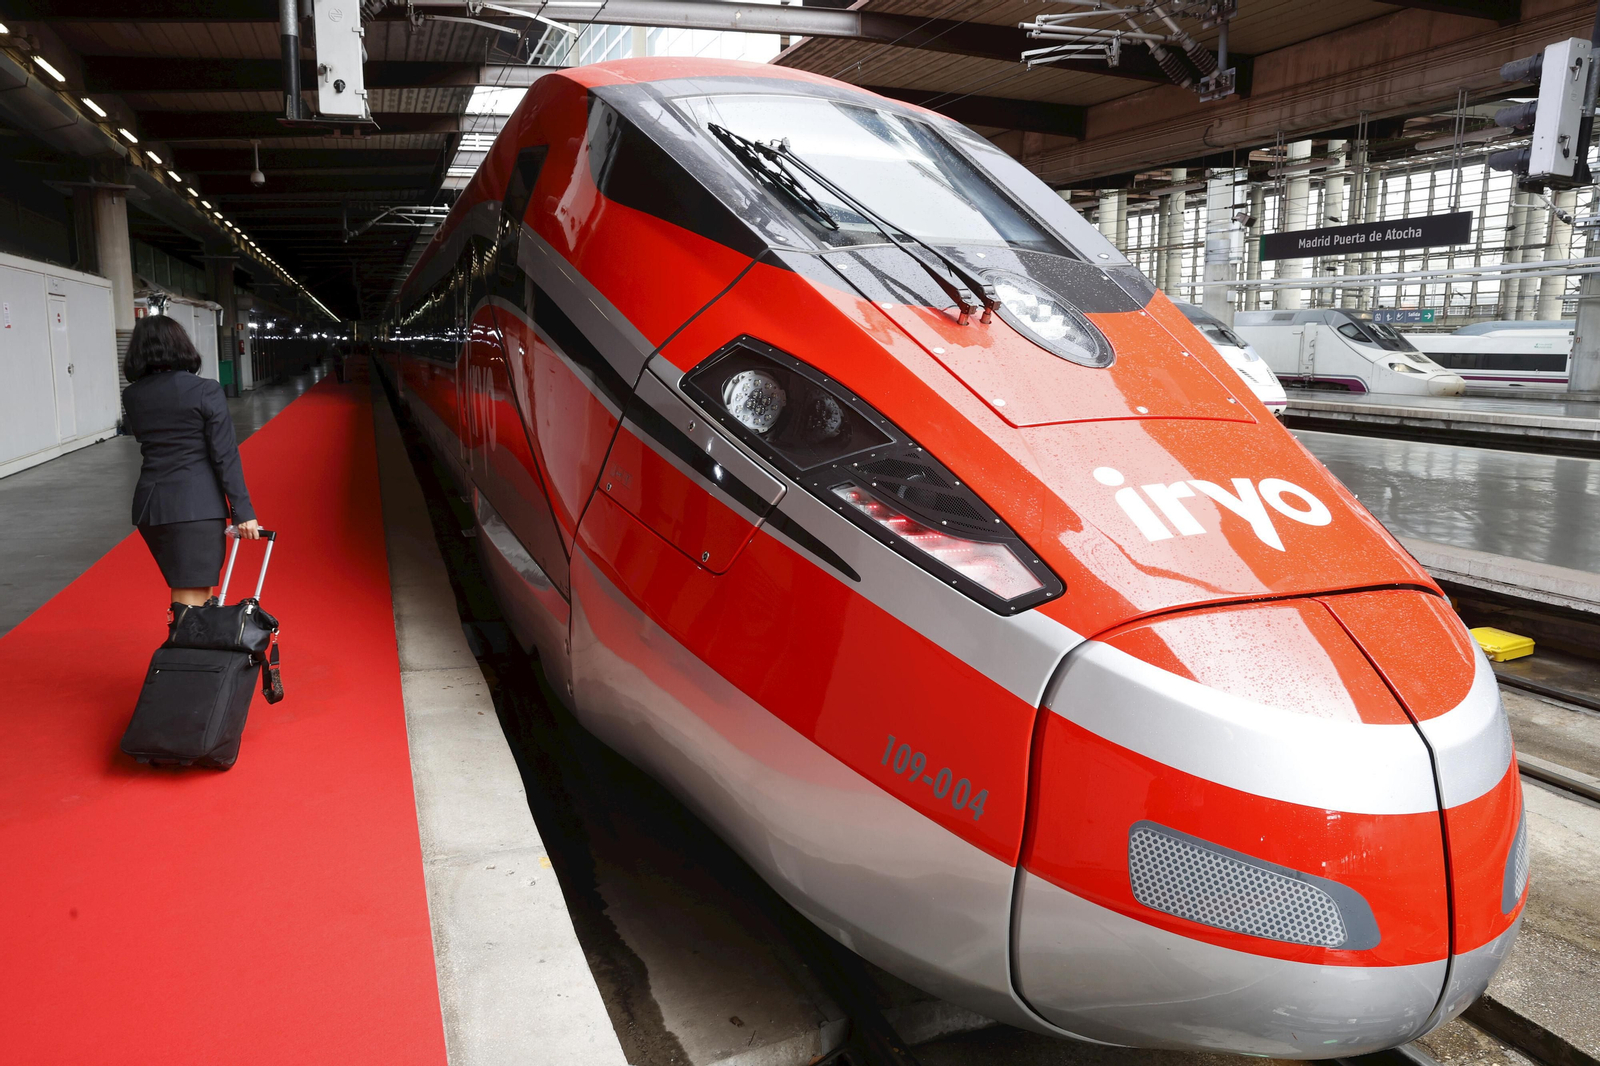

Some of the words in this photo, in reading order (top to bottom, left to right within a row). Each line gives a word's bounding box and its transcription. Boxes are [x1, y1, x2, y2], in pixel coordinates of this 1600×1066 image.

[1298, 235, 1331, 249] Madrid
[1333, 232, 1366, 246] Puerta
[1369, 230, 1382, 242] de
[1385, 227, 1422, 240] Atocha
[1093, 466, 1332, 552] iryo
[881, 734, 989, 821] 109-004
